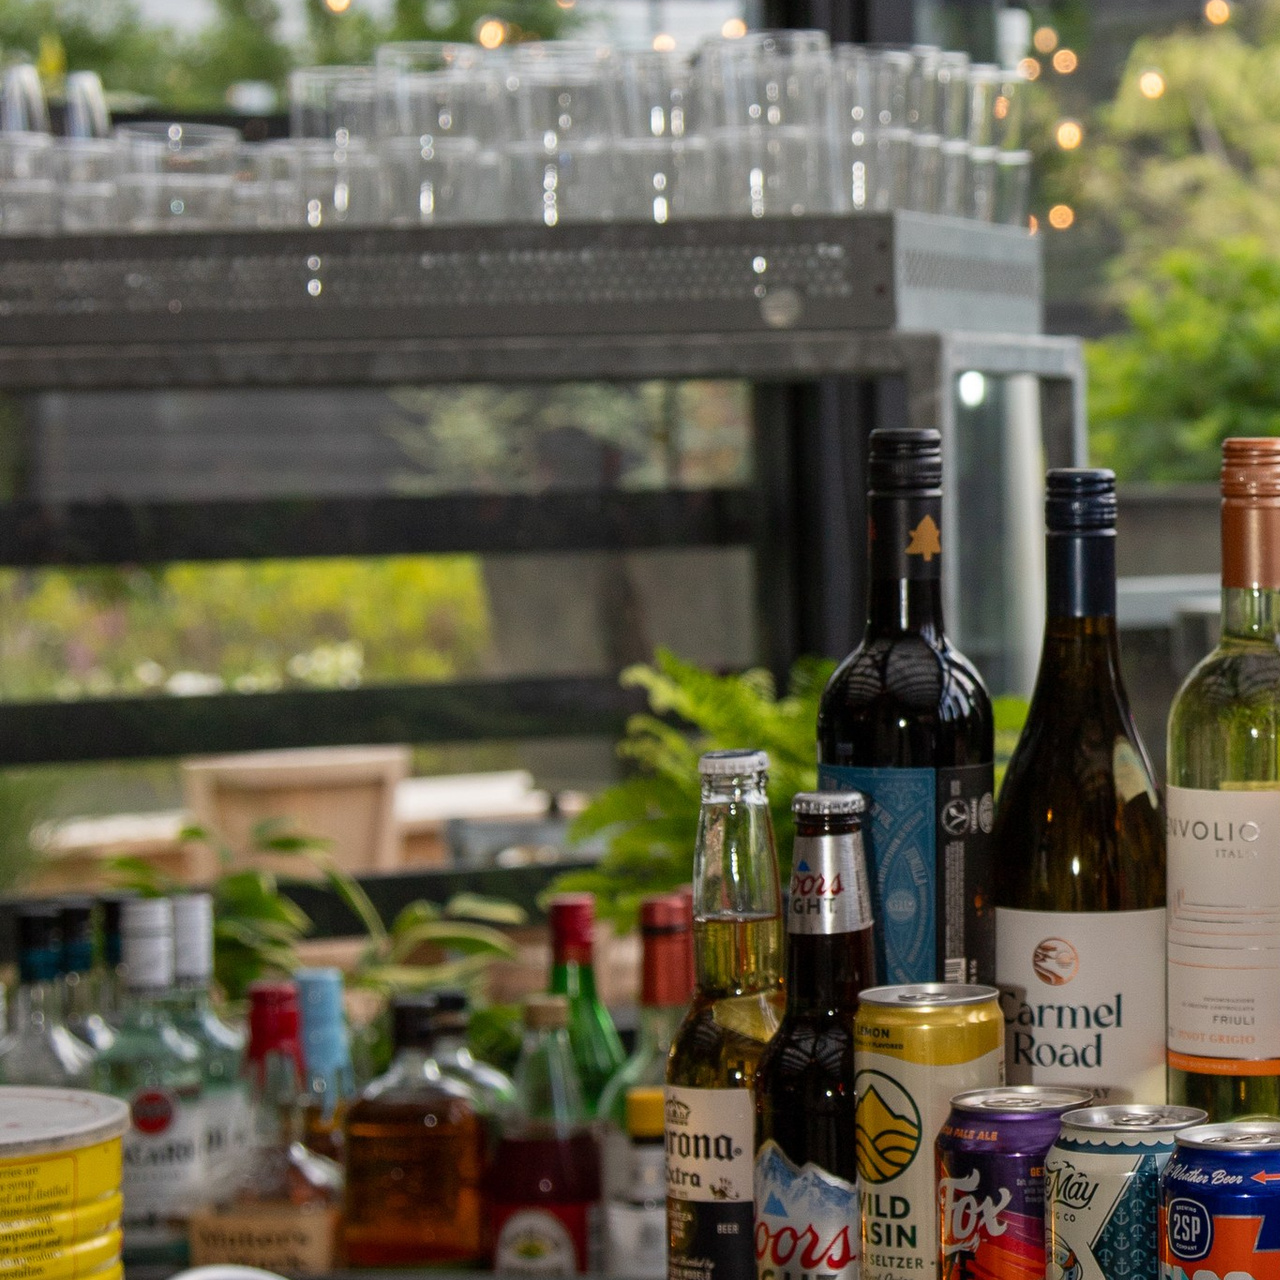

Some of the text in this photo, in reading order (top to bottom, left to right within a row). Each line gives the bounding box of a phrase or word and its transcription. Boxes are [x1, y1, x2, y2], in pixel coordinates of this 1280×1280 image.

[1212, 1015, 1255, 1026] FRIULI
[857, 1024, 890, 1039] LEMON
[1209, 1034, 1256, 1045] GRIGIO
[1013, 1032, 1104, 1069] Road
[954, 1128, 975, 1140] PALE
[976, 1130, 998, 1141] ALE
[1211, 1170, 1243, 1185] Beer
[1176, 1205, 1197, 1213] BREWING
[1064, 1213, 1076, 1222] CO
[717, 1223, 739, 1234] BEER
[1173, 1213, 1201, 1242] 2SP
[1176, 1242, 1198, 1251] COMPANY
[870, 1255, 924, 1270] SELTZER
